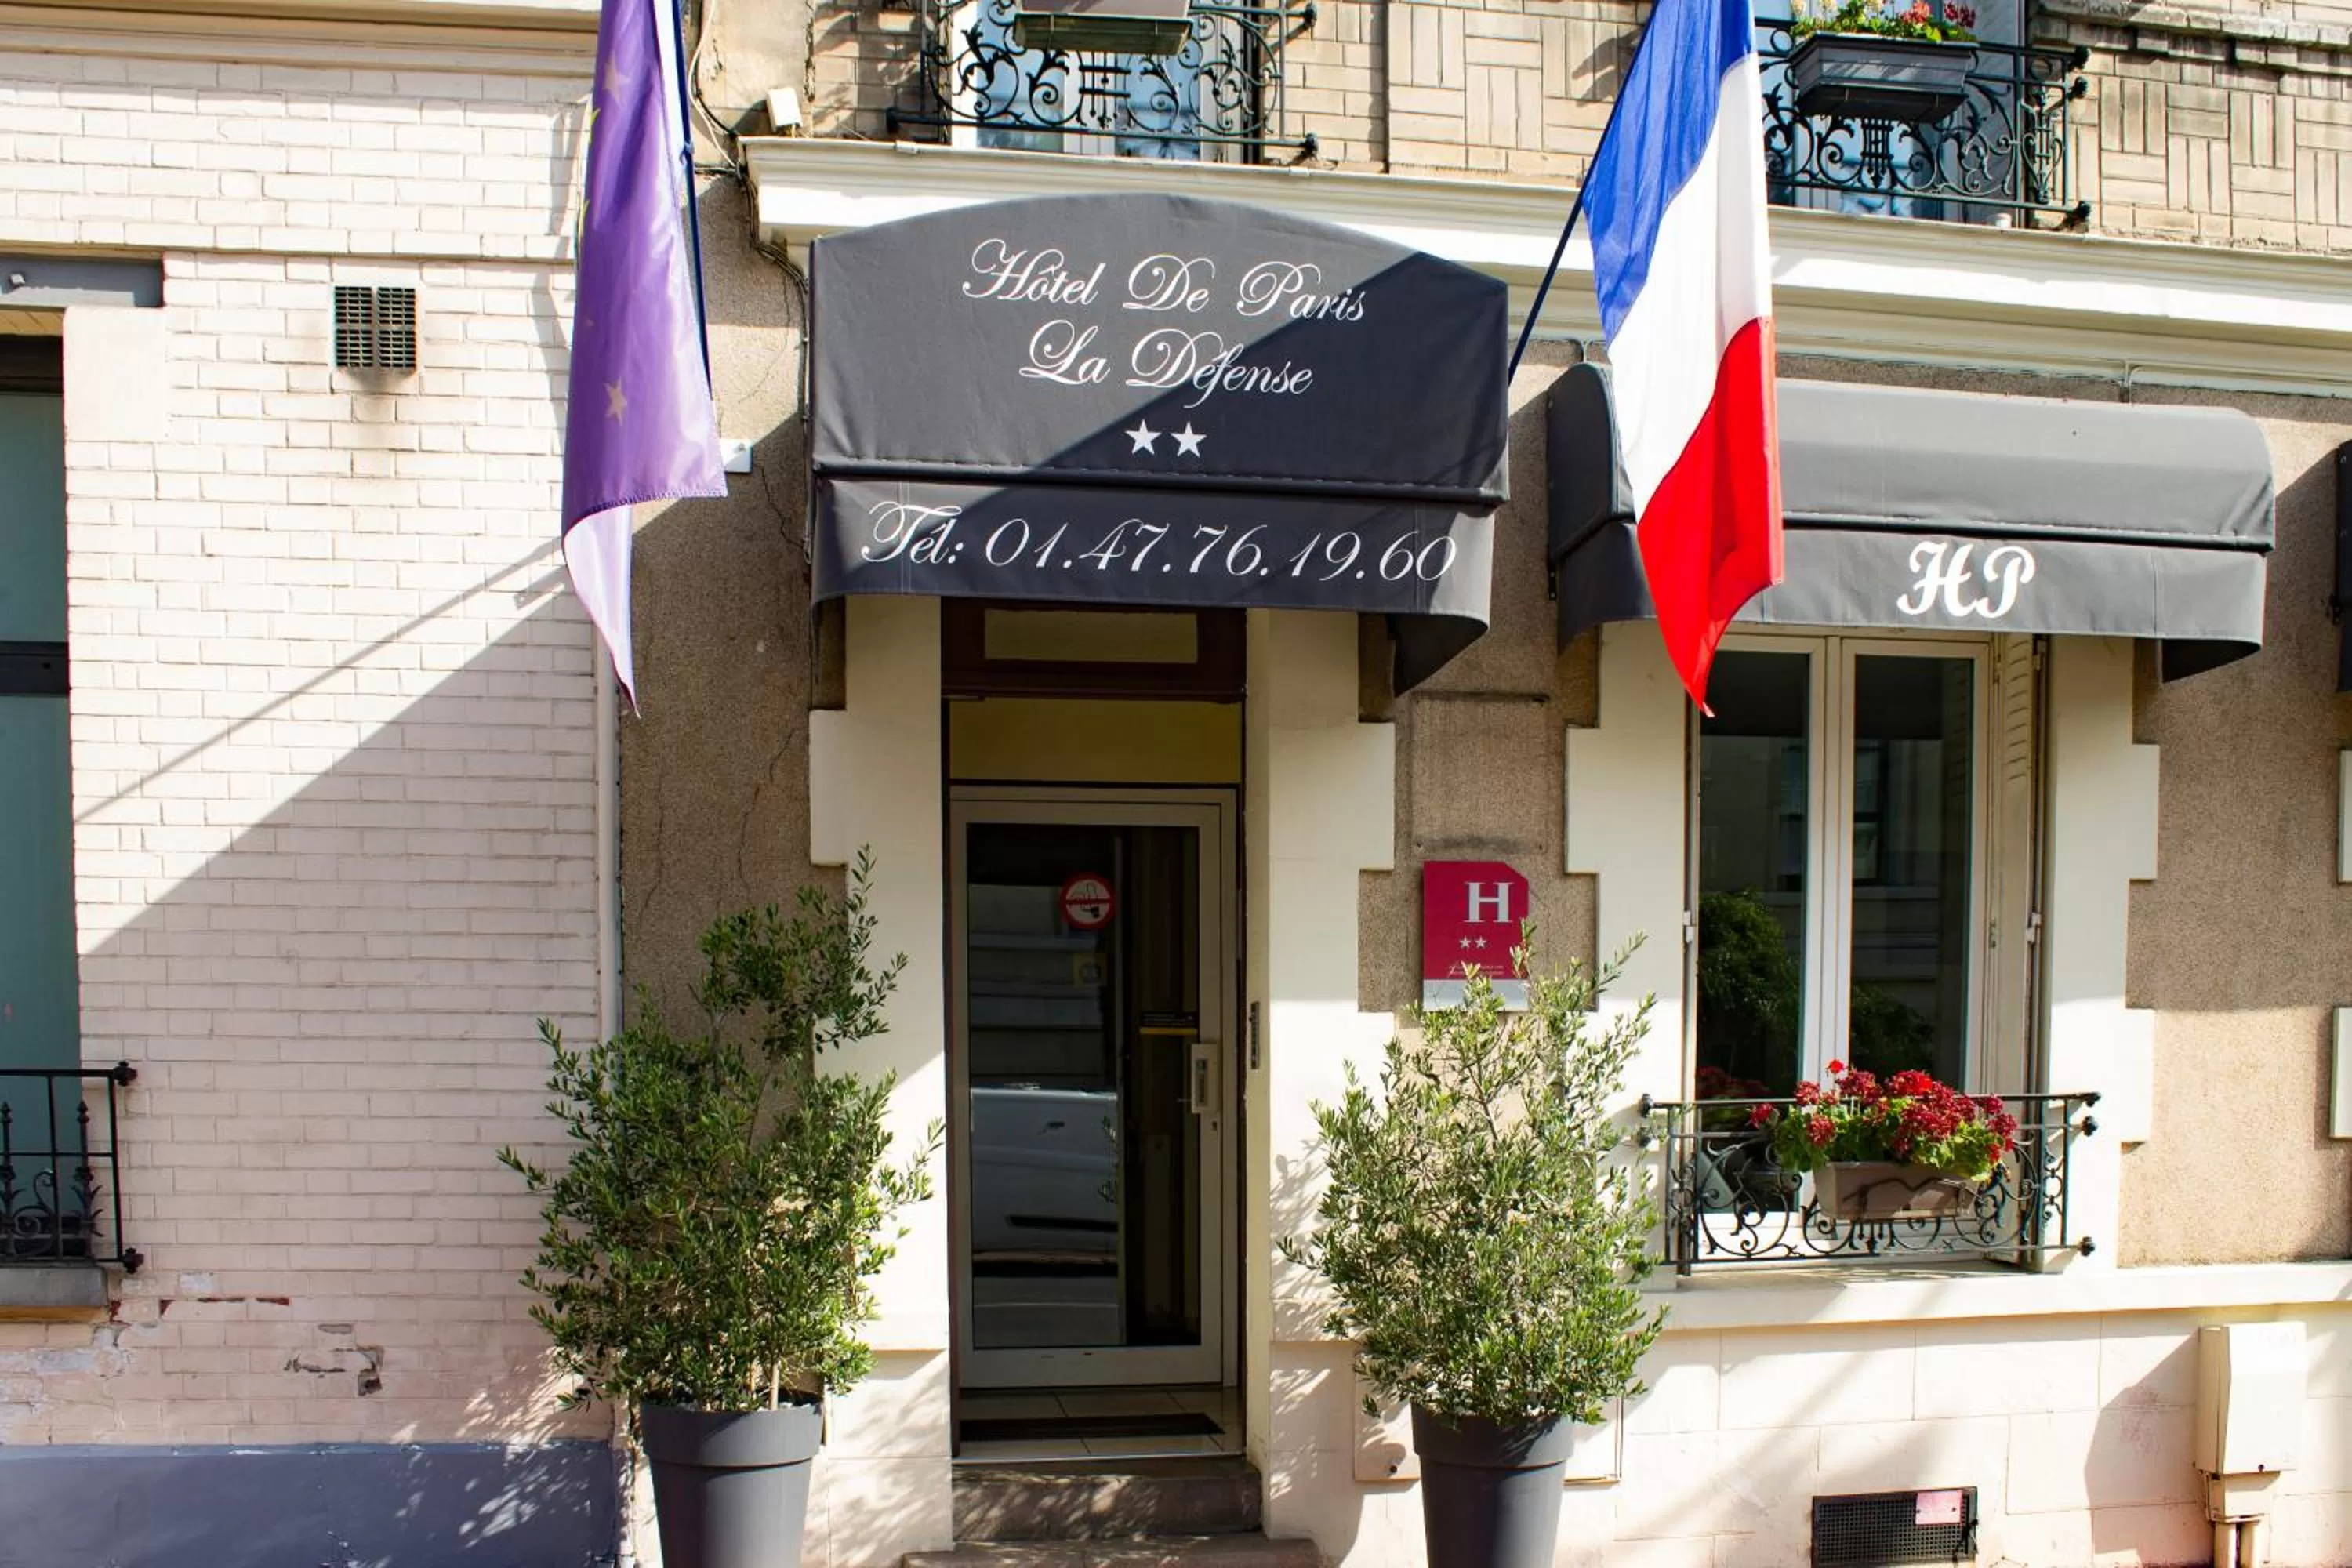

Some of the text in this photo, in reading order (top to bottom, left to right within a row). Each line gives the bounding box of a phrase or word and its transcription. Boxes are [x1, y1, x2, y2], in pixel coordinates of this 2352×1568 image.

[962, 238, 1367, 321] Hôtel De Paris
[1019, 319, 1314, 408] La Défense
[862, 501, 1456, 582] Tél: 01.47.76.19.60
[1896, 541, 2035, 618] HP
[1462, 882, 1514, 923] H
